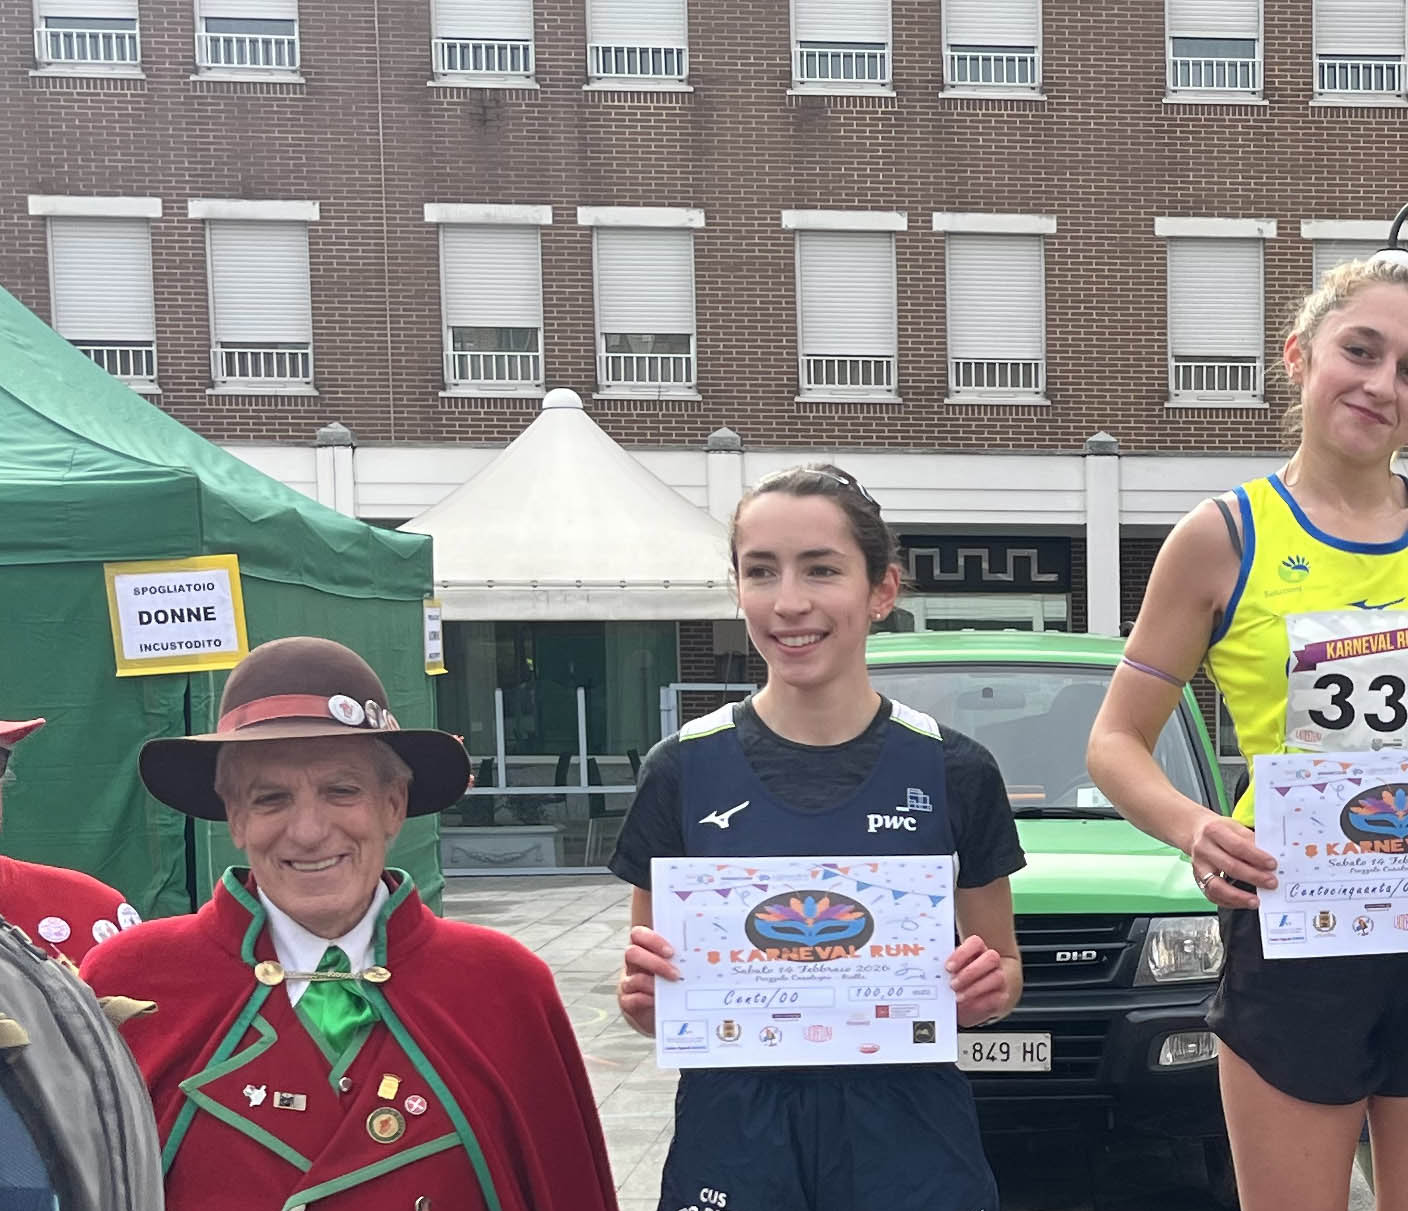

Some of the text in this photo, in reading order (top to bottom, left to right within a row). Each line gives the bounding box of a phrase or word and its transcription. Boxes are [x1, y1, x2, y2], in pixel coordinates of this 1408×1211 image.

[133, 581, 215, 597] SPOGLIATOIO
[138, 605, 217, 627] DONNE
[139, 638, 222, 653] INCUSTODITO
[1326, 635, 1394, 660] KARNEVAL
[867, 813, 917, 833] pwc
[730, 945, 861, 963] KARNEVAL
[870, 943, 925, 957] RUN
[799, 963, 851, 974] Febbraio
[855, 963, 890, 973] 2026
[854, 986, 904, 1000] 100,00
[972, 1041, 1048, 1063] 849 HC
[700, 1187, 727, 1208] CUS
